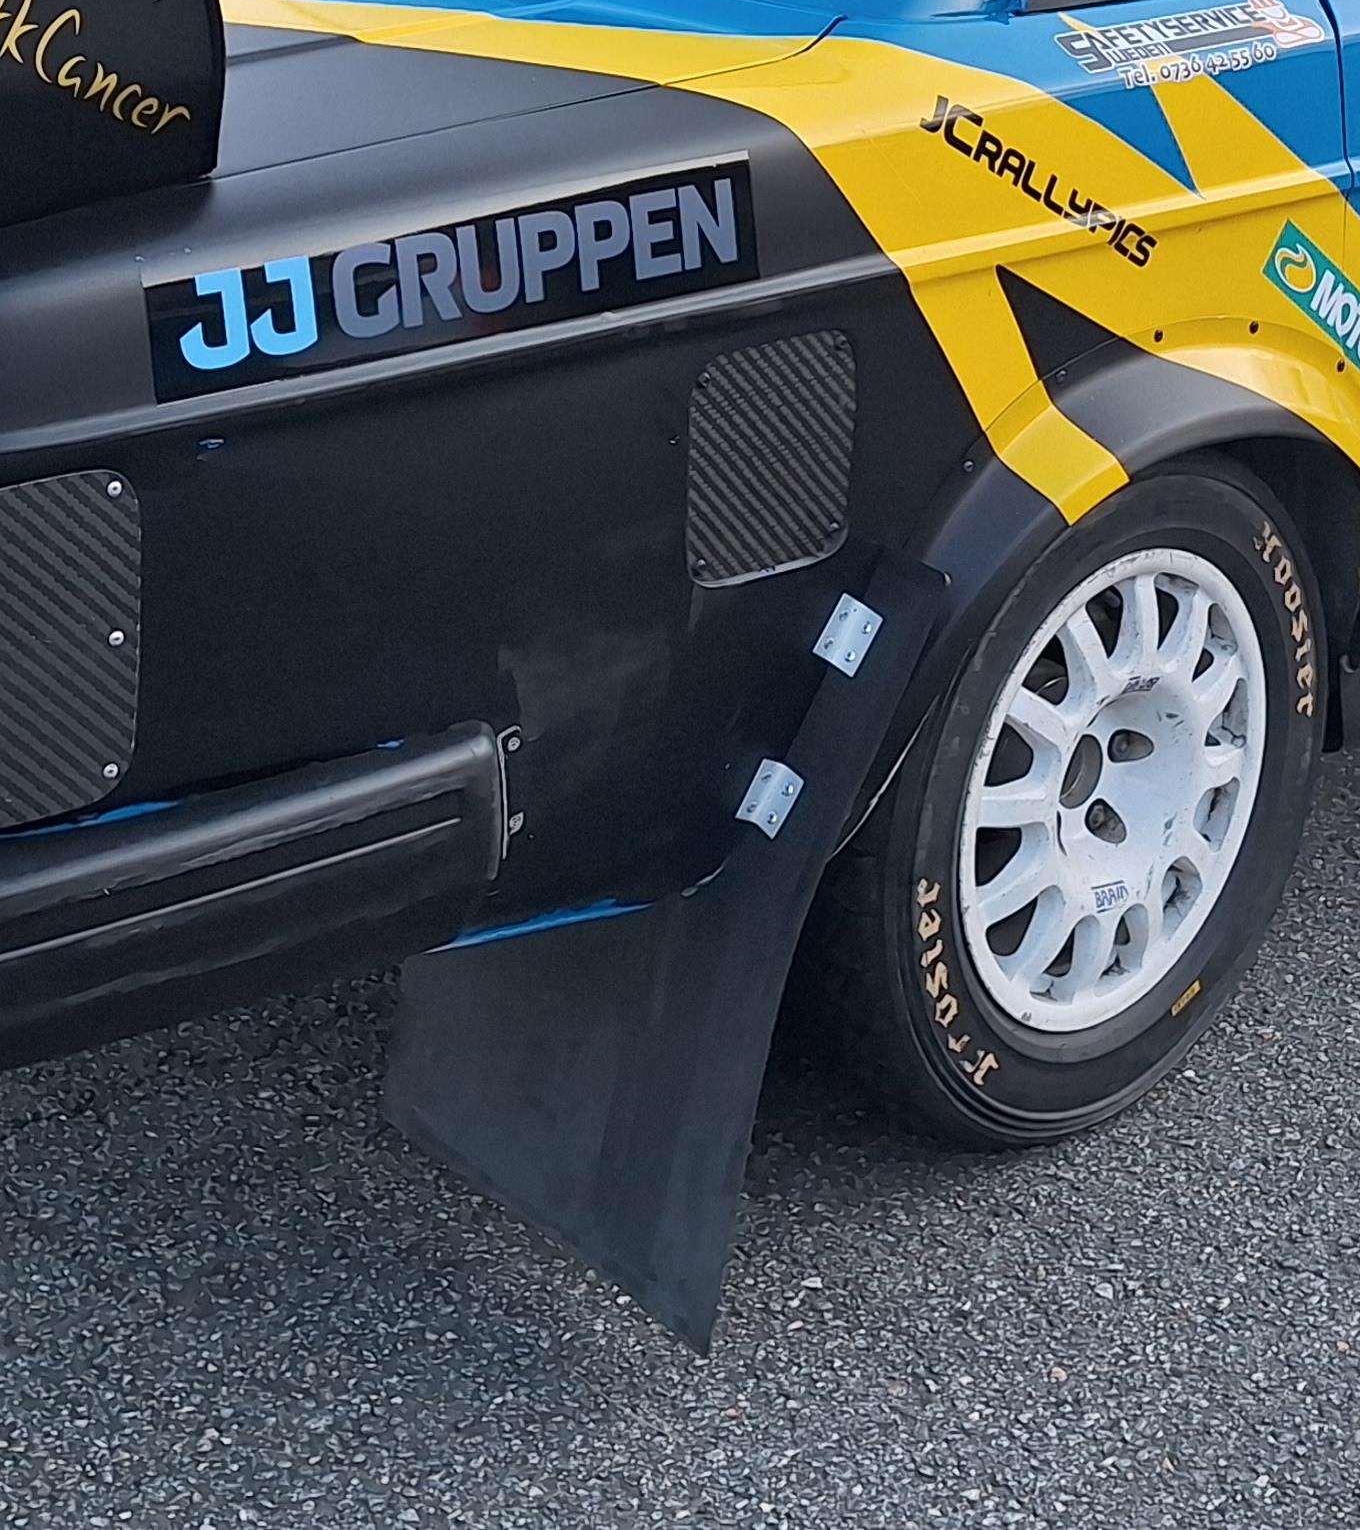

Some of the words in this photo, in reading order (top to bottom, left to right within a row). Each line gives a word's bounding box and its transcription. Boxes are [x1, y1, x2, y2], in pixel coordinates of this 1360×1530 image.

[1121, 68, 1155, 89] Tel.
[1160, 54, 1202, 81] 0736
[1205, 52, 1228, 74] 42
[1228, 47, 1250, 68] 55
[1252, 40, 1277, 62] 60
[179, 255, 318, 370] JJ
[332, 177, 739, 338] GRUPPEN
